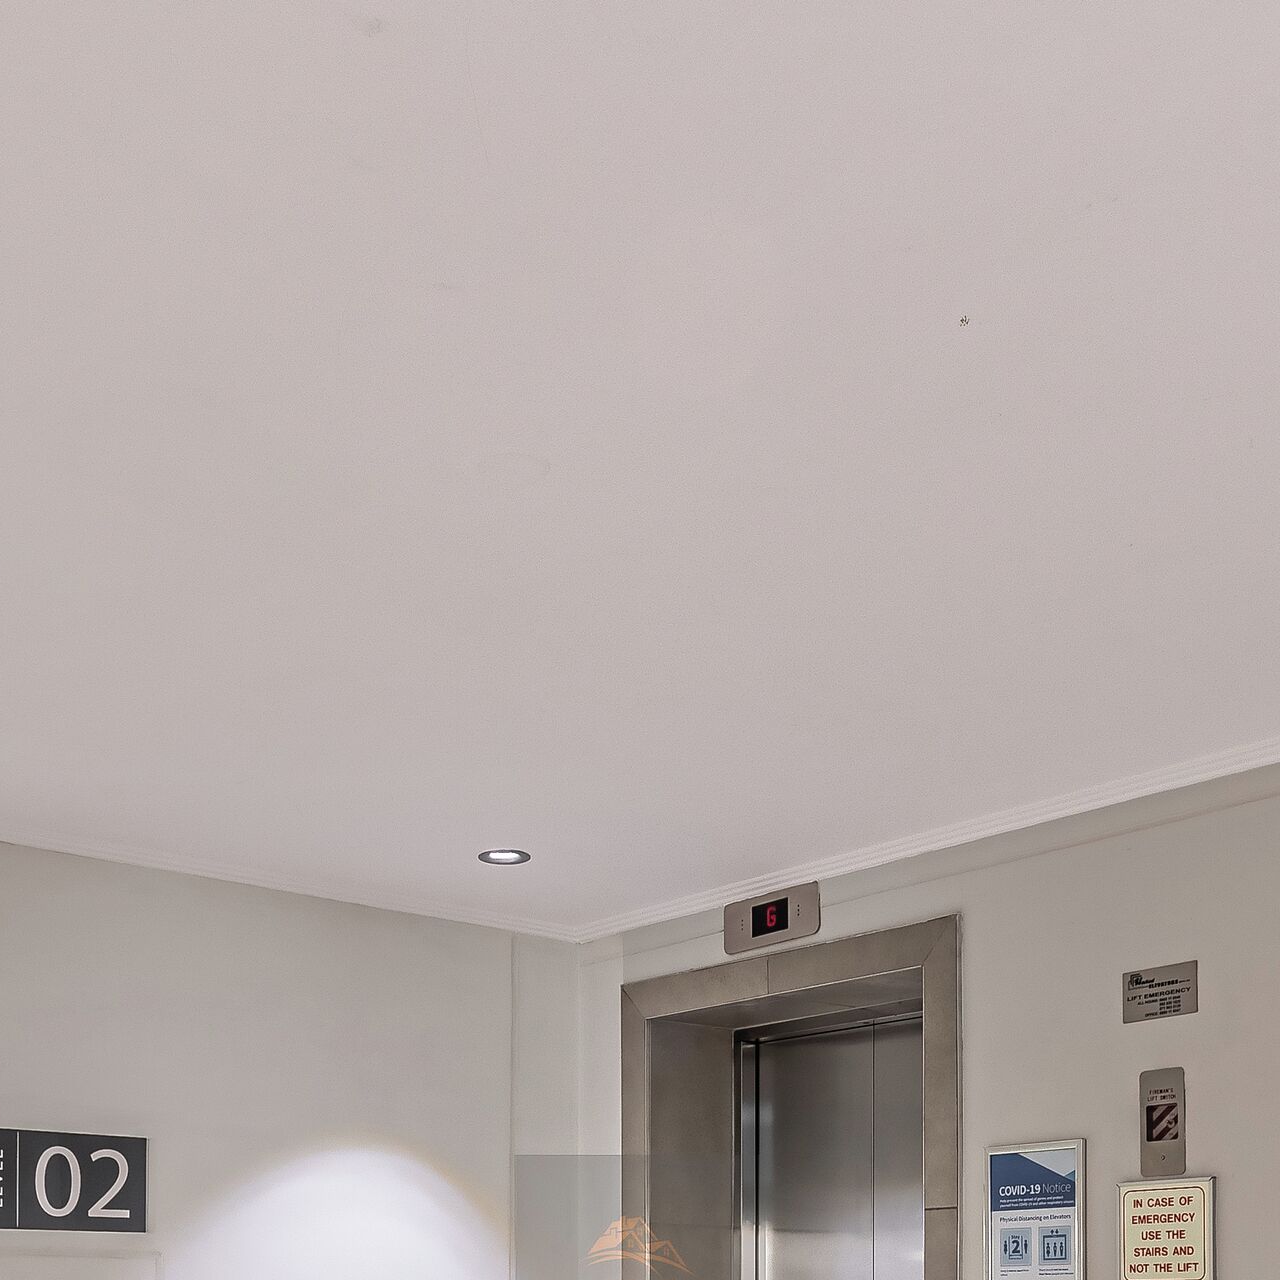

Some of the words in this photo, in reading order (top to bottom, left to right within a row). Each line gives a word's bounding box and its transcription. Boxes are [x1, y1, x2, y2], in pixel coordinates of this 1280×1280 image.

[766, 905, 777, 928] G
[1127, 994, 1143, 1002] LIFT
[1144, 986, 1192, 999] EMERGENCY
[34, 1145, 131, 1219] 02
[999, 1184, 1041, 1196] COVID-19
[1042, 1183, 1071, 1194] Notice
[1133, 1199, 1143, 1208] IN
[1147, 1197, 1174, 1208] CASE
[1178, 1196, 1194, 1206] OF
[1018, 1214, 1043, 1222] Distancing
[1131, 1213, 1195, 1224] EMERGENCY
[1141, 1230, 1162, 1241] USE
[1166, 1229, 1186, 1239] THE
[1011, 1240, 1020, 1254] 2
[1133, 1246, 1168, 1257] STAIRS
[1172, 1246, 1195, 1256] AND
[1129, 1263, 1149, 1273] NOT
[1153, 1263, 1173, 1272] THE
[1177, 1262, 1199, 1272] LIFT
